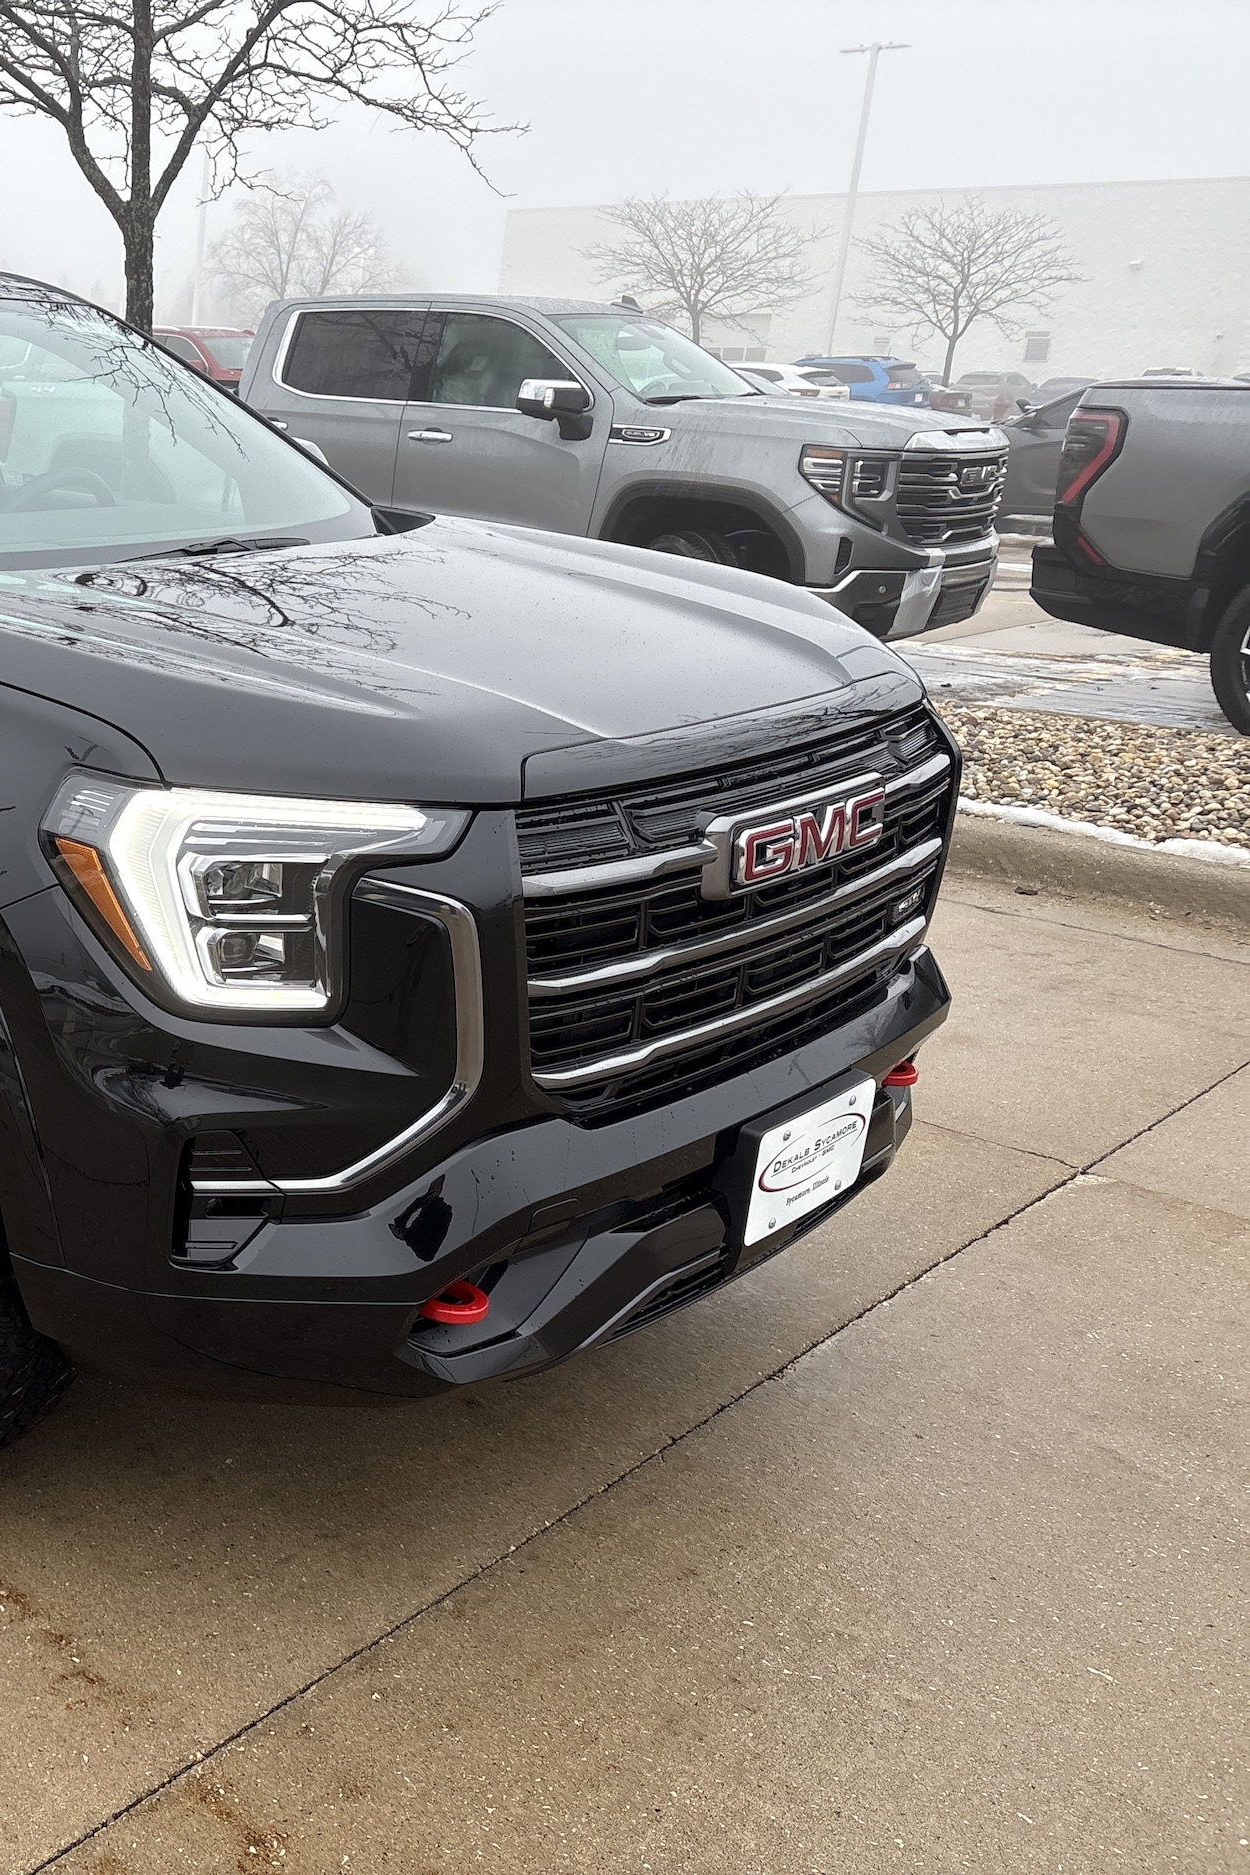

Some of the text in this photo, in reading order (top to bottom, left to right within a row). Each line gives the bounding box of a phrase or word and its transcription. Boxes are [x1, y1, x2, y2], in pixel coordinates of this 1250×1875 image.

[735, 787, 886, 885] GMC
[773, 1120, 858, 1174] DEKALB SYCAMORE
[791, 1144, 835, 1174] CHEVROLET GMC
